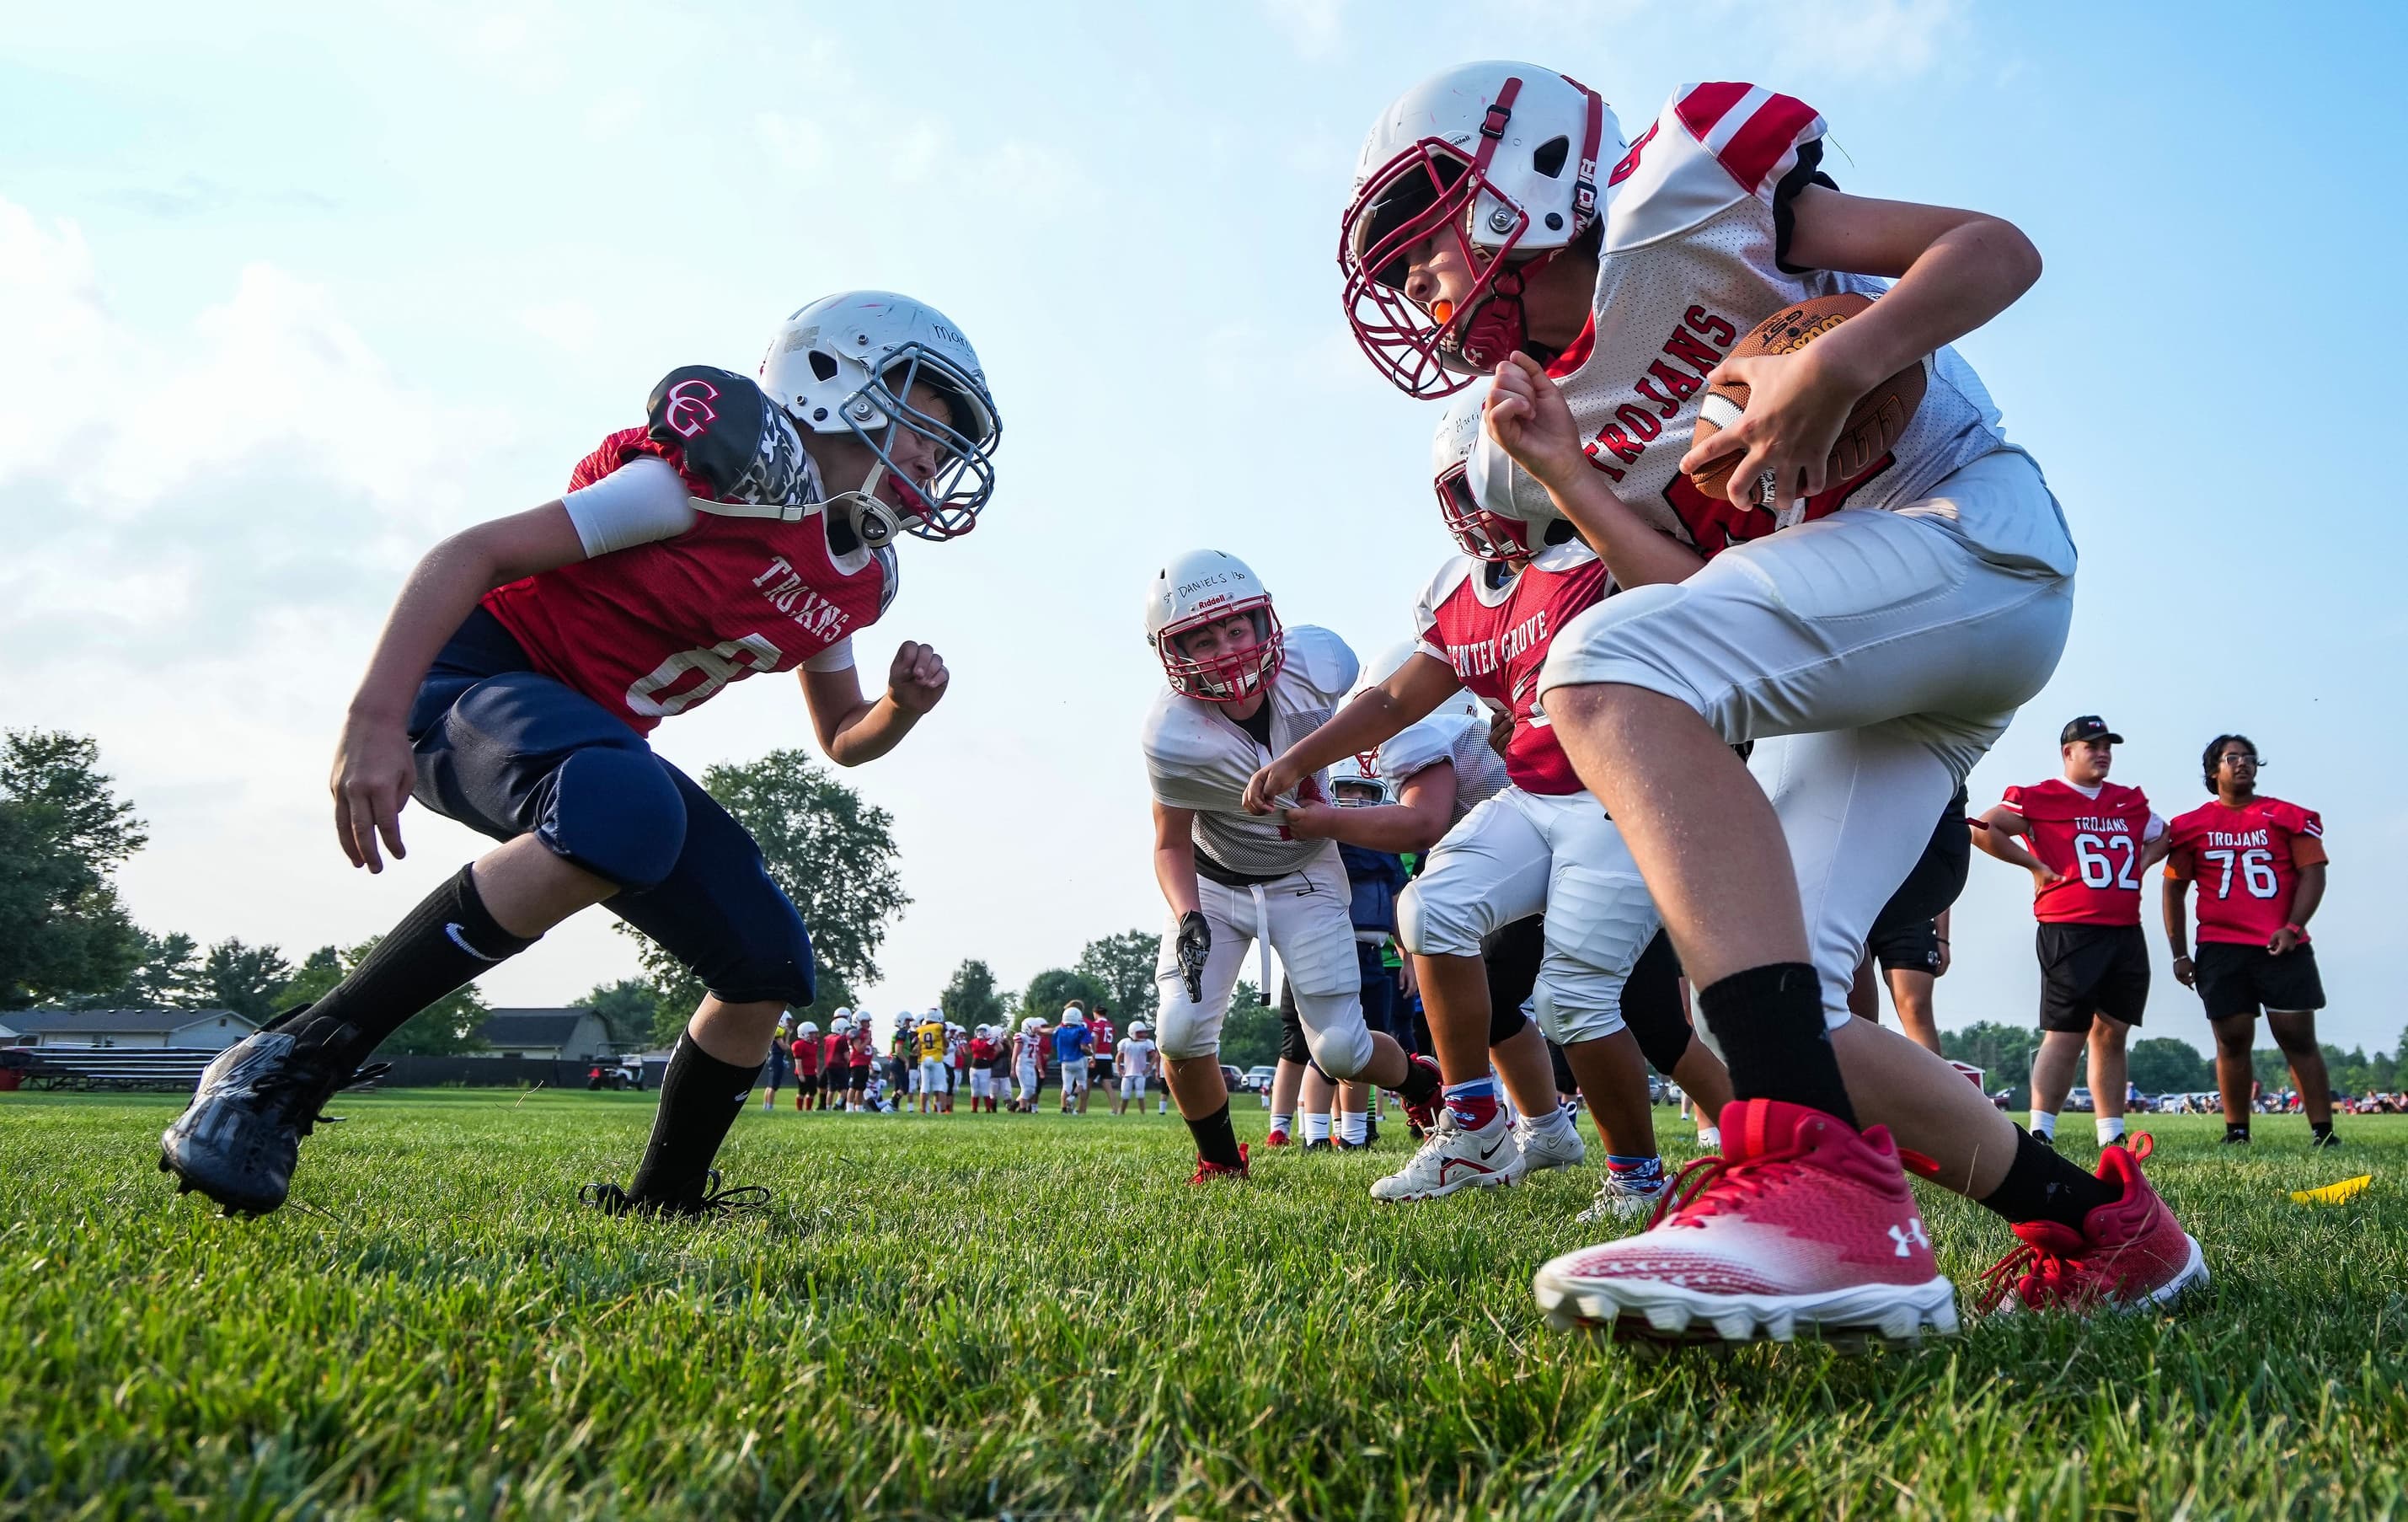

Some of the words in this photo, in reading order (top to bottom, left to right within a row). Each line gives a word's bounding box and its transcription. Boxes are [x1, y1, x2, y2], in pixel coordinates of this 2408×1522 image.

[1451, 135, 1471, 147] ddell
[1762, 309, 1804, 348] GST
[1583, 304, 1736, 483] TROJANS
[1178, 573, 1228, 598] DANIELS
[752, 555, 850, 643] TROJANS
[1198, 593, 1226, 609] Riddell
[1501, 609, 1548, 663] GROVE
[2074, 817, 2129, 832] TROJANS
[2207, 828, 2269, 847] TROJANS
[2074, 833, 2139, 890] 62
[2204, 848, 2278, 900] 76
[923, 1032, 934, 1050] 9
[1103, 1026, 1113, 1043] 15
